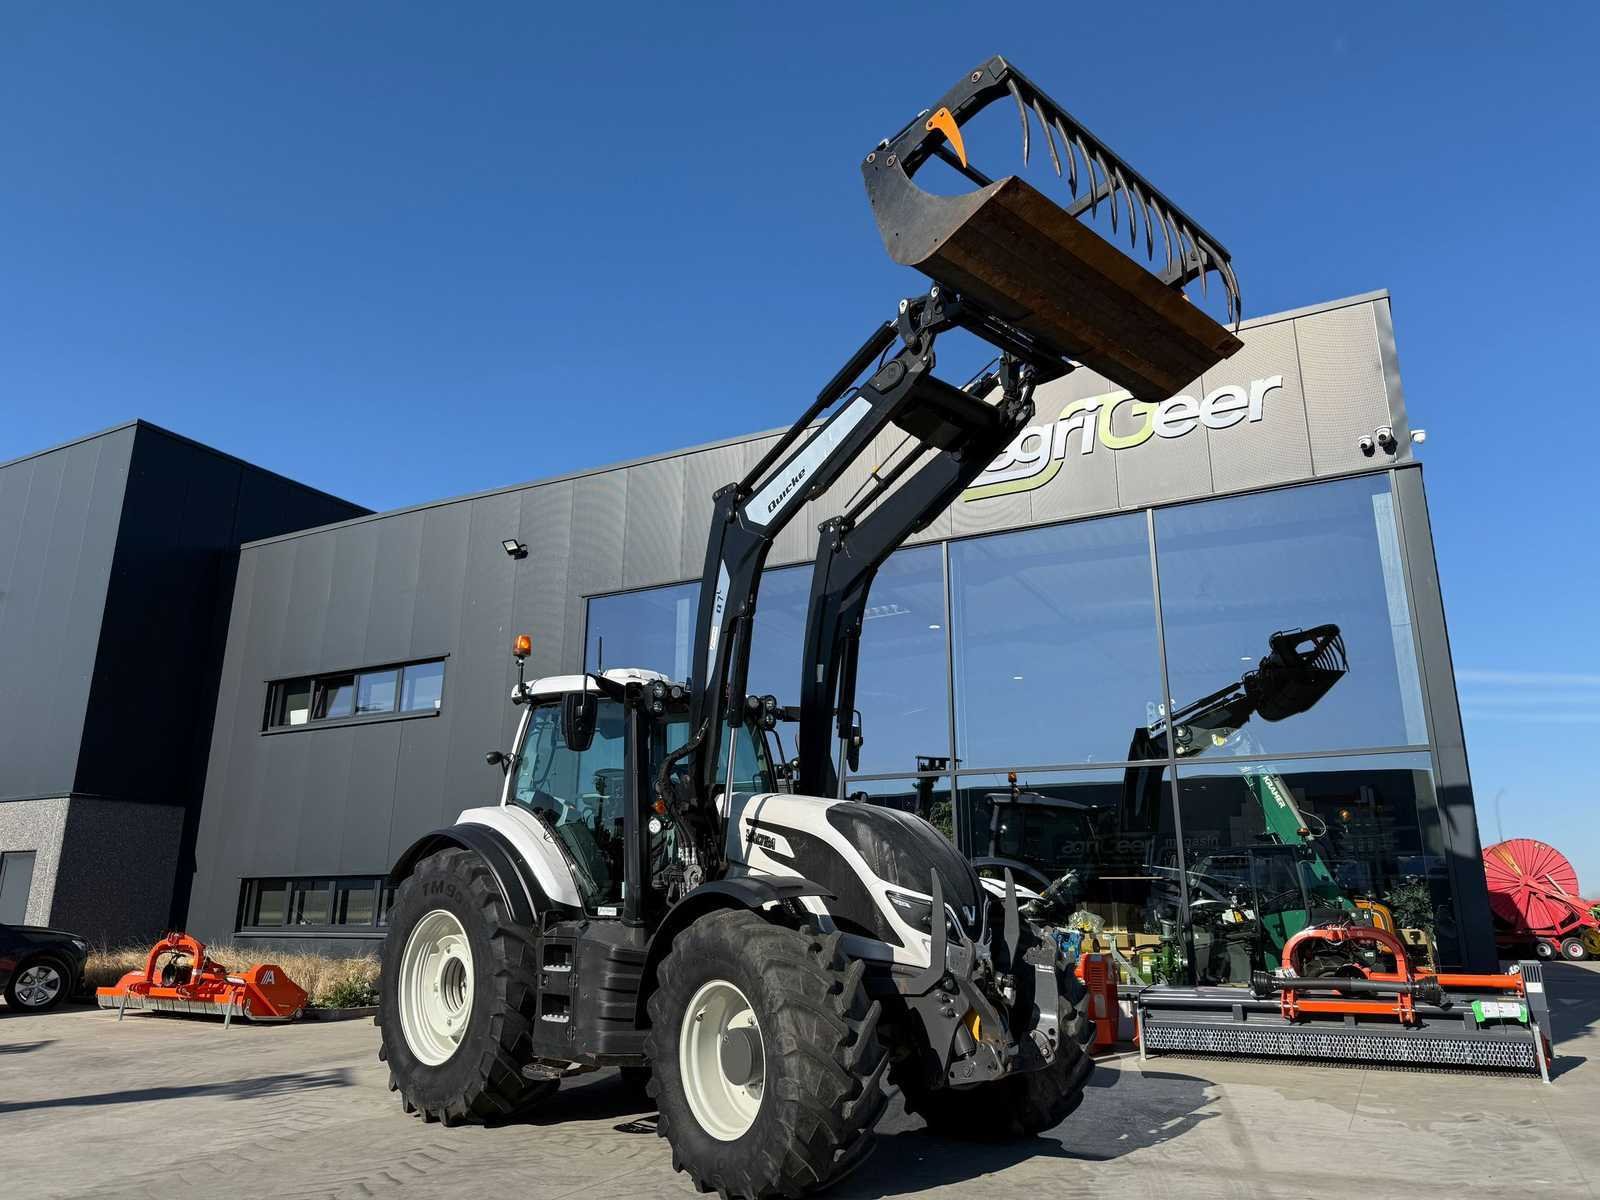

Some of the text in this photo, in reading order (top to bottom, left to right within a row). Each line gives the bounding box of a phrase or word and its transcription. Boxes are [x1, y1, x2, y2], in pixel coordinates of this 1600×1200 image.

[965, 375, 1283, 500] griGeer
[767, 468, 806, 514] Quicke
[1263, 775, 1286, 808] KRAMER
[1167, 835, 1219, 849] mgasin
